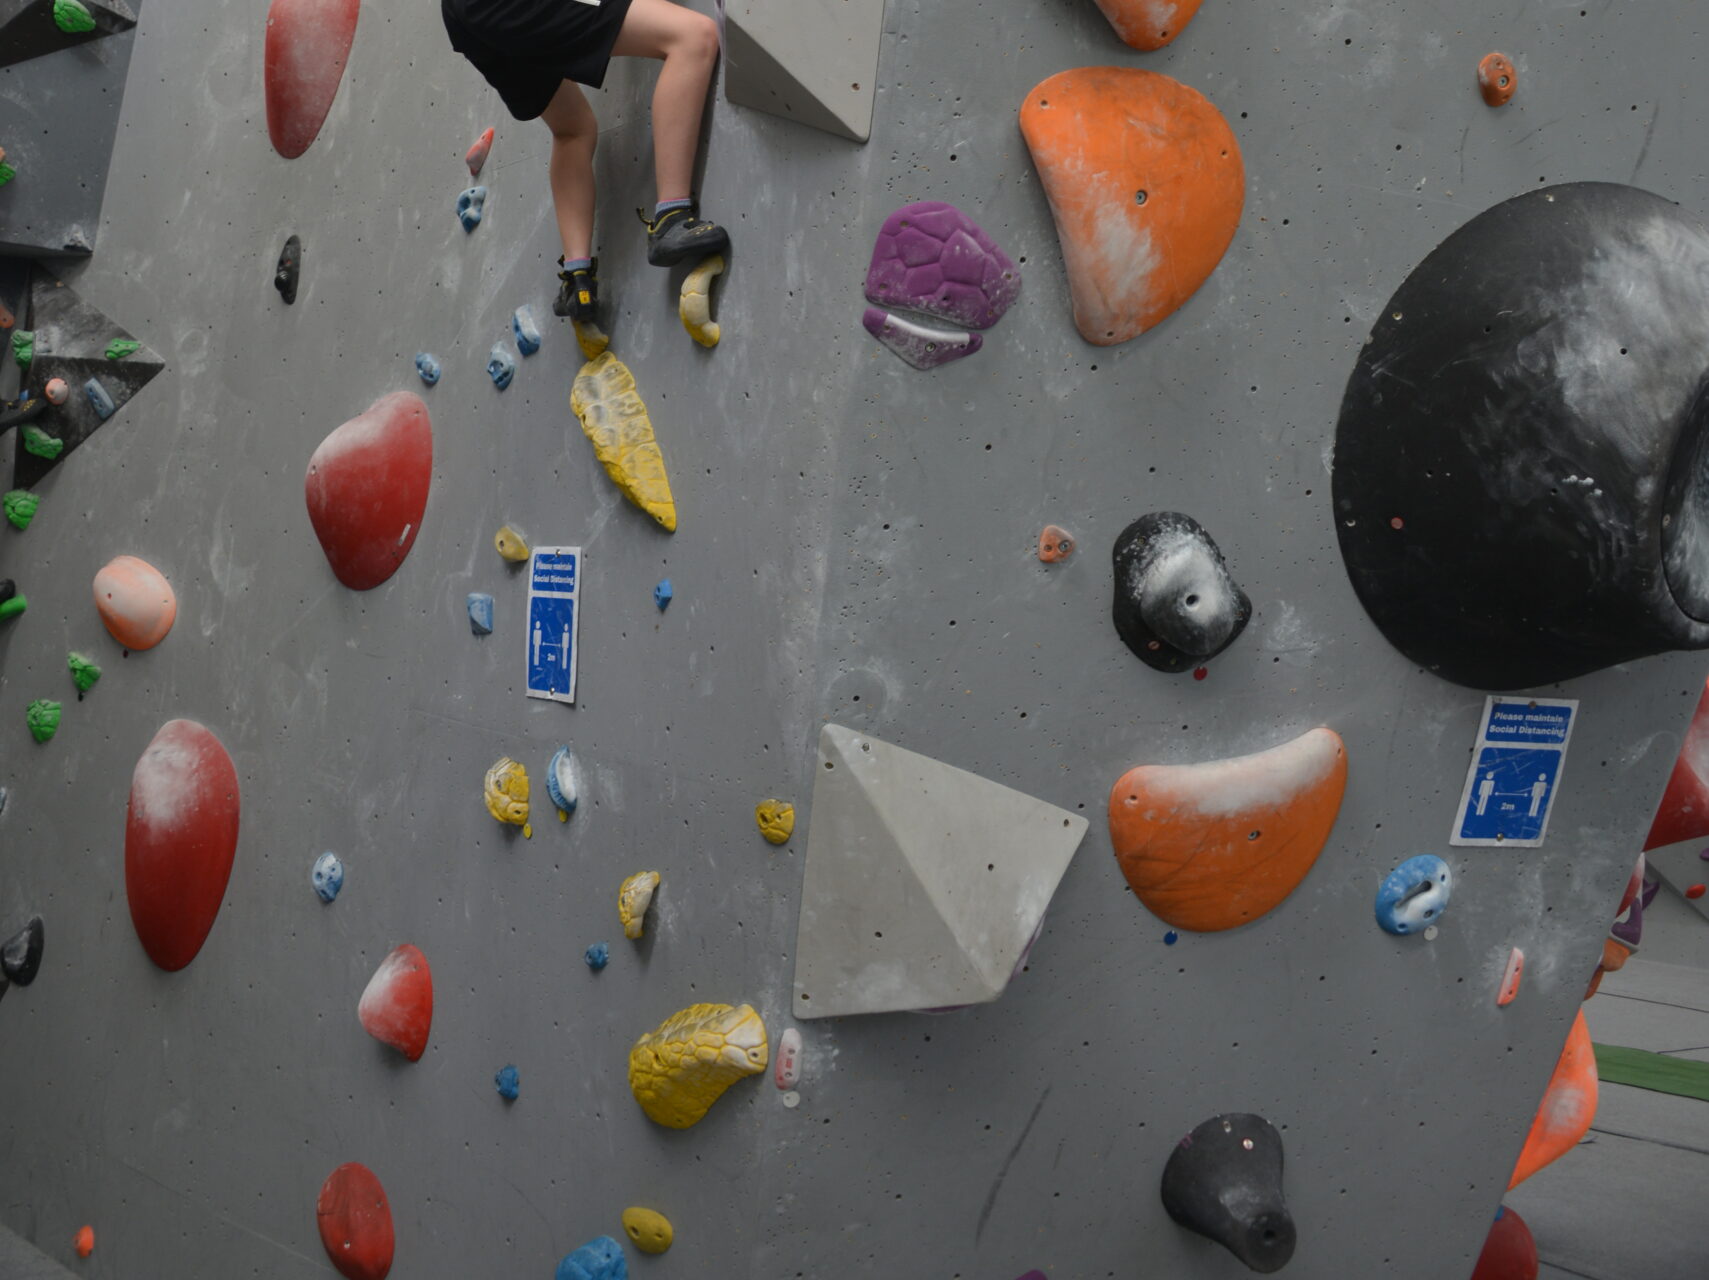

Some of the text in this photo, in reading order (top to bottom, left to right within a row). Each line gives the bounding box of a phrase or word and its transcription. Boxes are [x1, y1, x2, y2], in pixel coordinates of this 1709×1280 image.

[1494, 712, 1564, 723] Please maintain
[1489, 725, 1565, 738] Social Distancing
[1501, 802, 1515, 810] 2m
